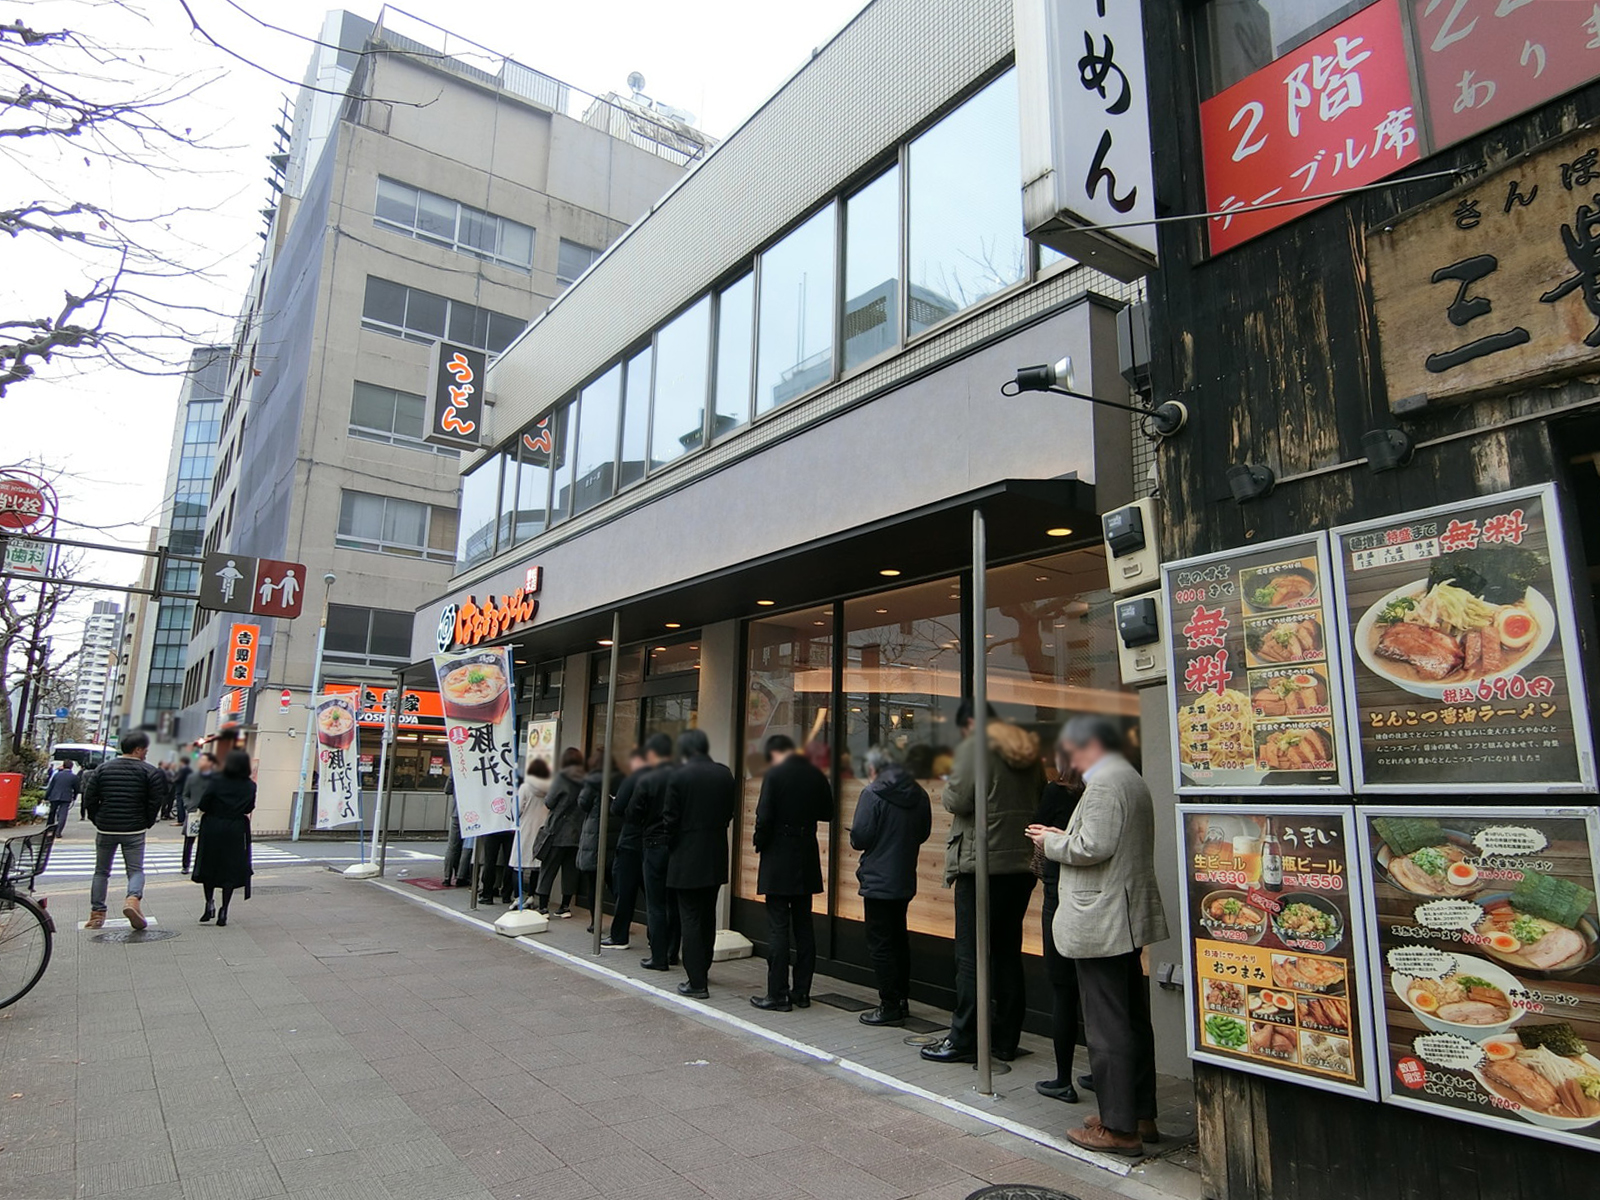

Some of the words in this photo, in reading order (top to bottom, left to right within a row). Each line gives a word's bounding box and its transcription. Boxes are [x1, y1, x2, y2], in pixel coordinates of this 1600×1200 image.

[1078, 0, 1136, 213] めん
[1228, 36, 1372, 162] 2階
[1213, 107, 1416, 231] テーブル席
[442, 352, 475, 435] うどん
[1439, 509, 1529, 553] 無料
[232, 630, 253, 680] 吉野家
[1183, 605, 1232, 696] 無料
[1370, 702, 1557, 727] とんこつ醤油ラーメン
[1283, 826, 1338, 849] うまい
[1194, 854, 1246, 871] 生ビール
[1282, 856, 1343, 875] 瓶ビール
[1213, 961, 1266, 980] おつまみ
